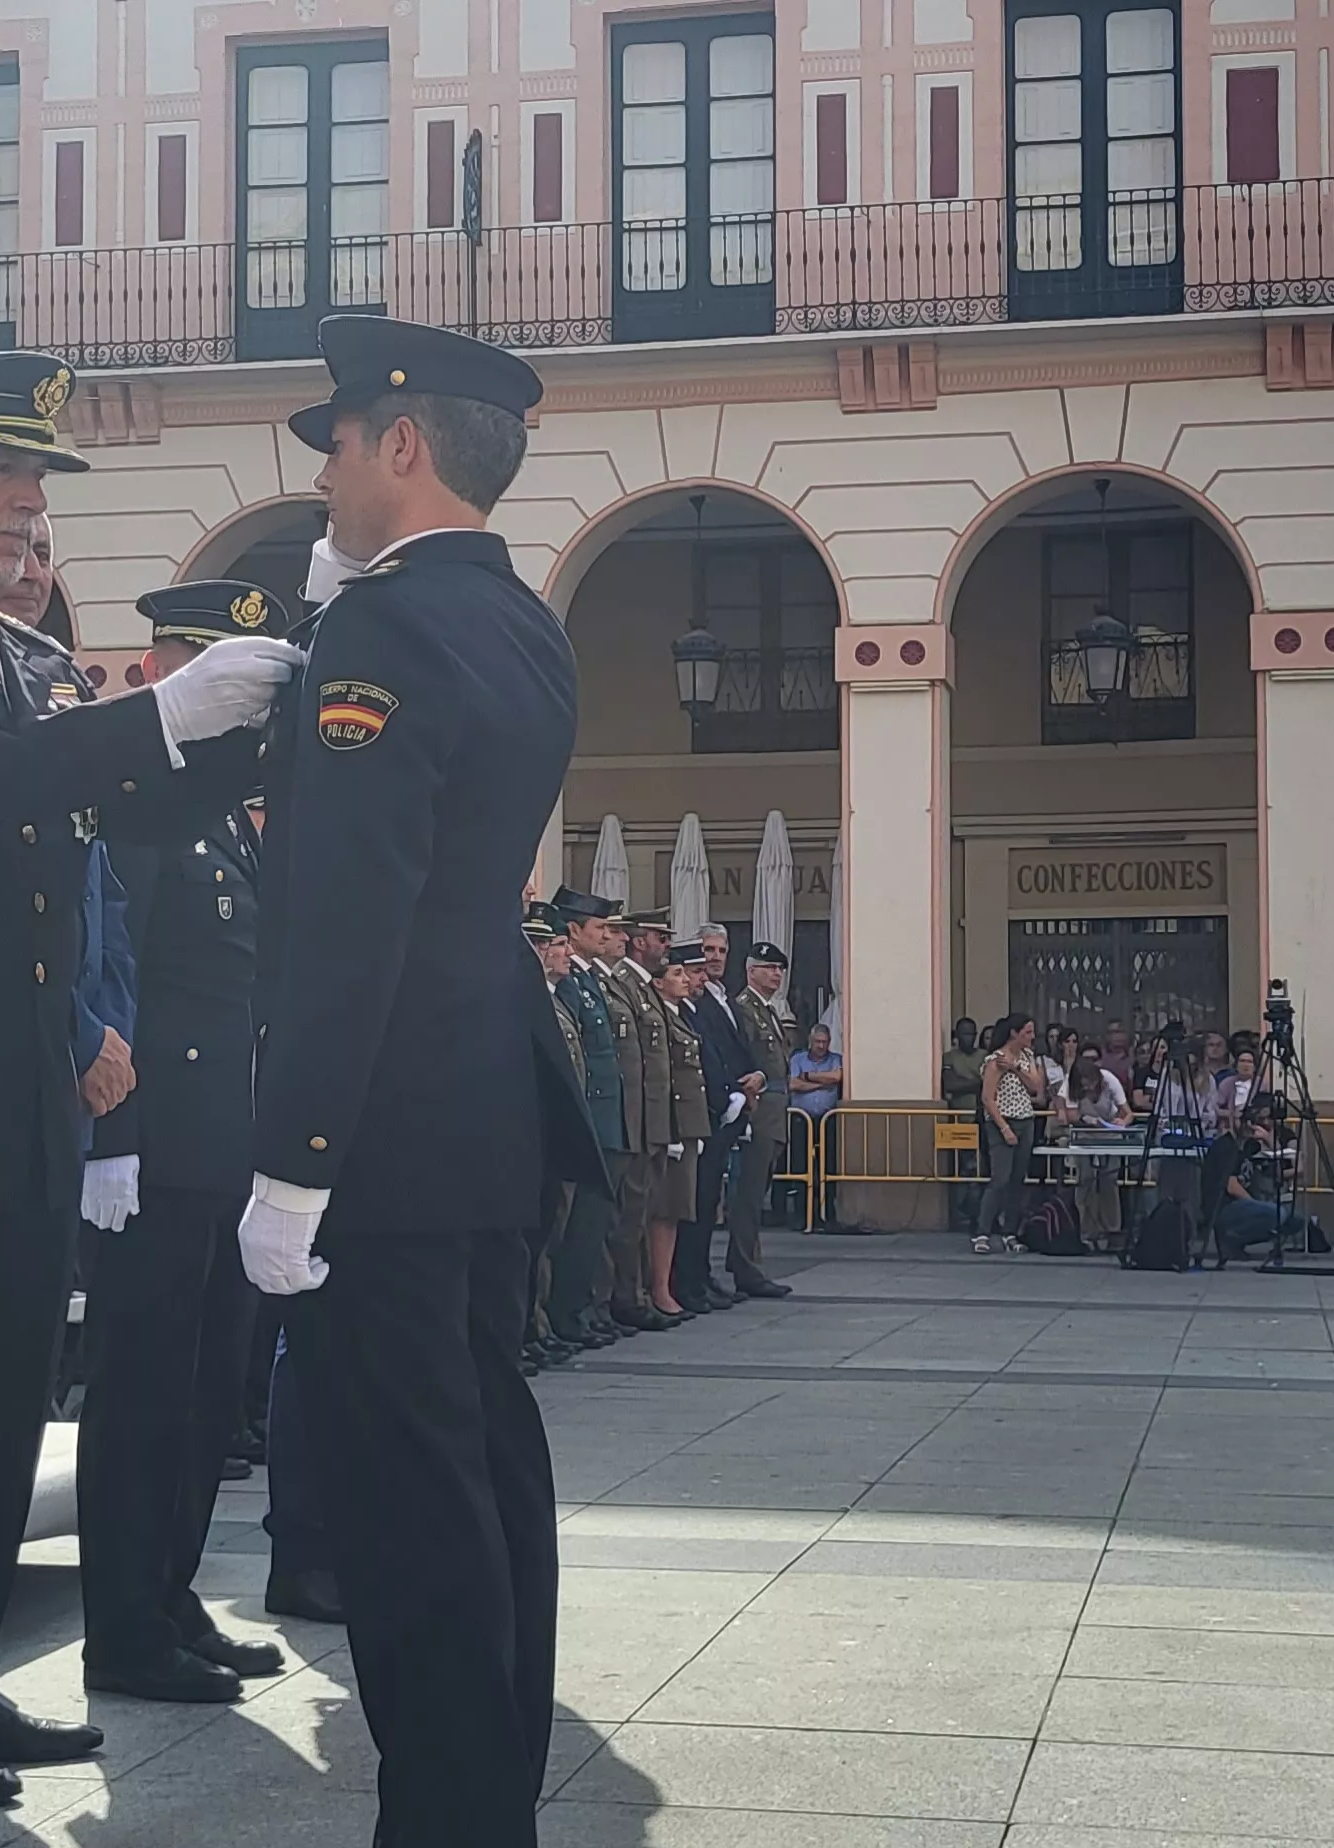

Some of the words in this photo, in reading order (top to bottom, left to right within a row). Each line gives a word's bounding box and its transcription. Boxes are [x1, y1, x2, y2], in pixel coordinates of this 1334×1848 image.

[322, 684, 348, 696] CUERPO
[351, 685, 394, 707] NACIONAL
[347, 693, 359, 702] DE
[327, 723, 367, 742] POLICIA
[1016, 860, 1214, 894] CONFECCIONES
